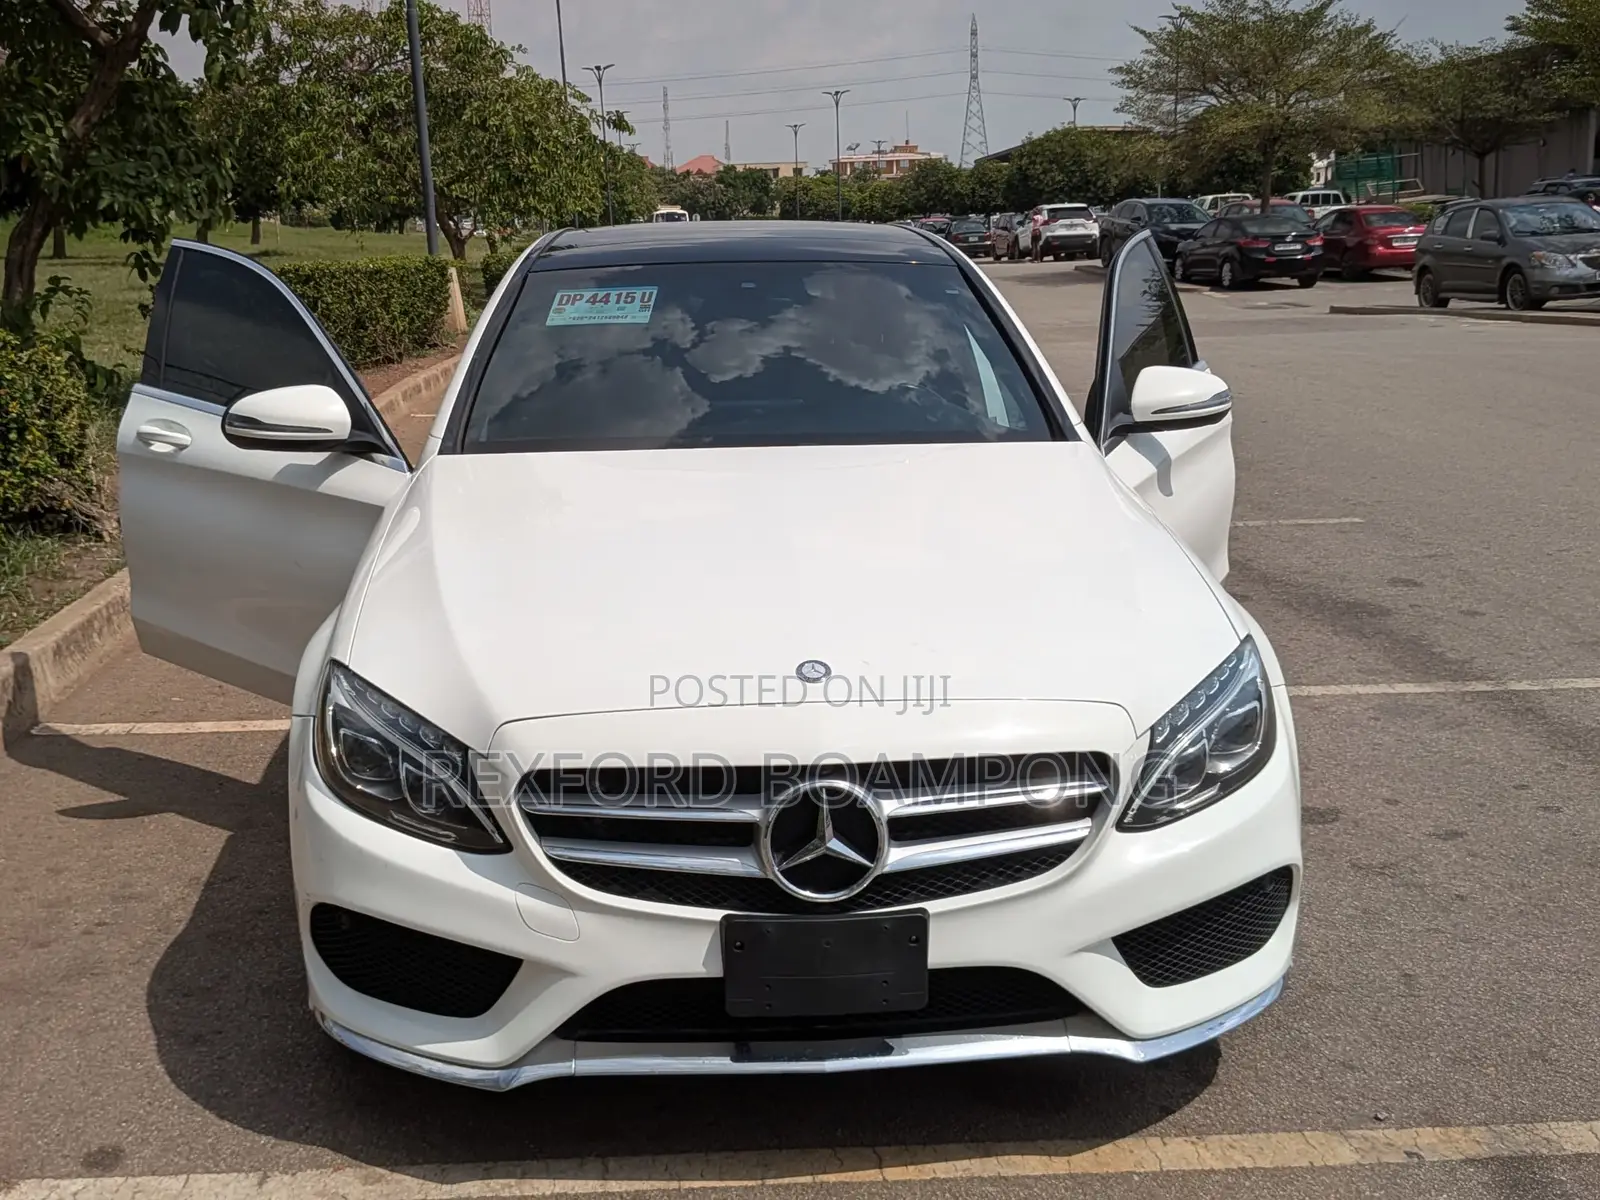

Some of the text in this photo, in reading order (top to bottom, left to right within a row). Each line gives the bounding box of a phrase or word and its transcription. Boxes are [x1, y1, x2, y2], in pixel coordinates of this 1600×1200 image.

[557, 291, 654, 307] DP 4415 U
